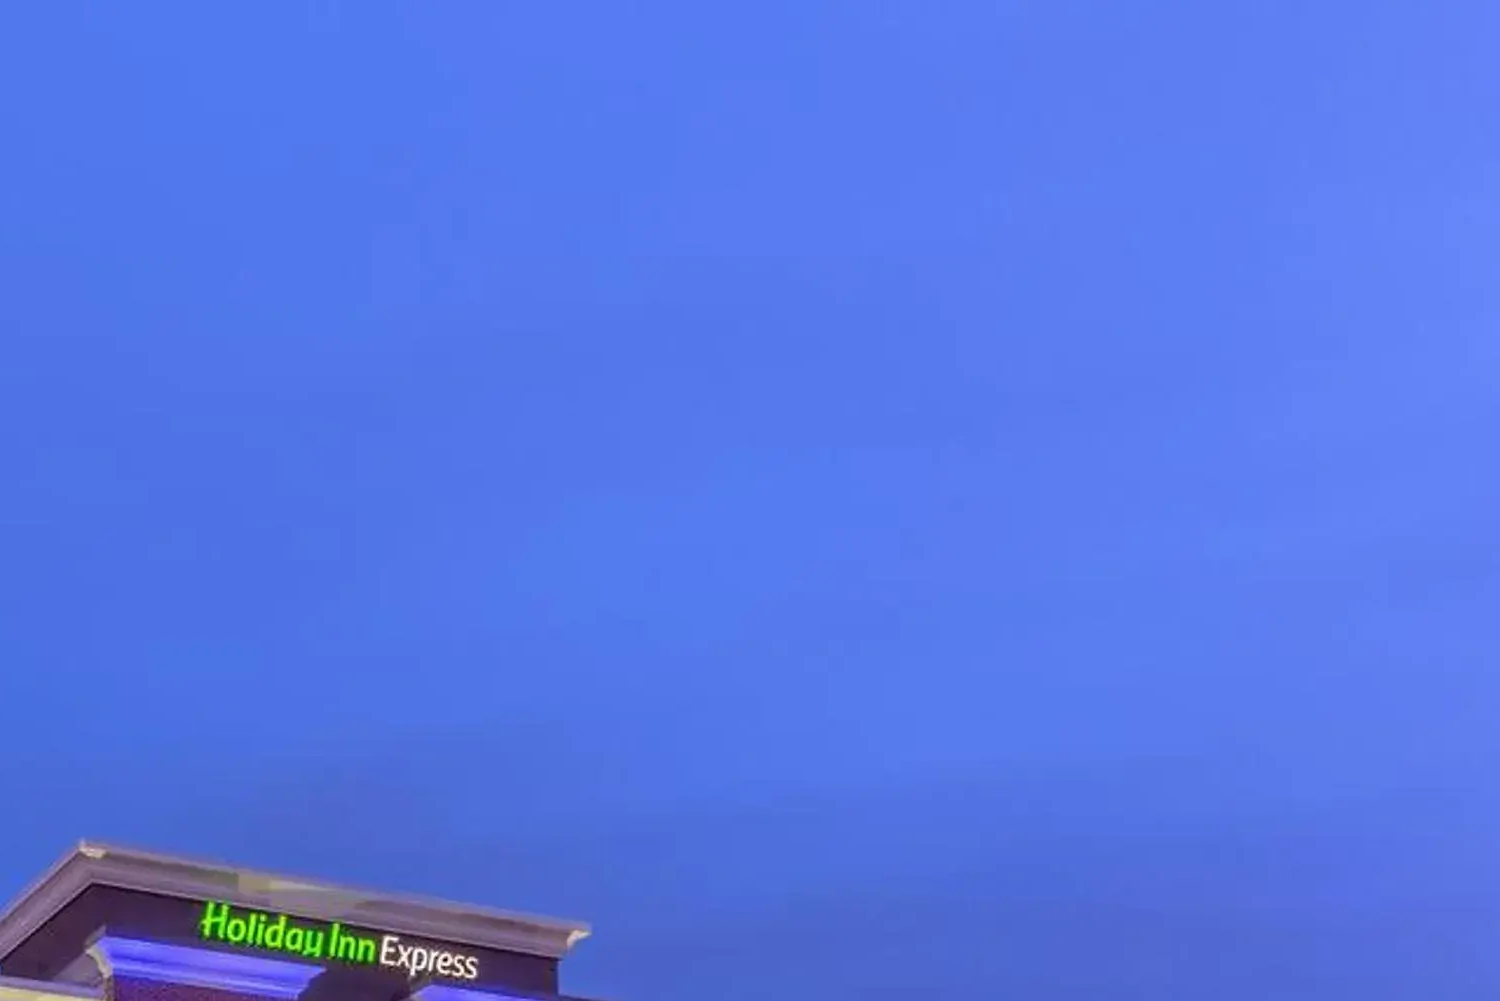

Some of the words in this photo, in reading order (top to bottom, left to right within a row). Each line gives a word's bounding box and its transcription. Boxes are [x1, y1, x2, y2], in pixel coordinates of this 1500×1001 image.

[200, 900, 324, 957] Holiday
[328, 922, 376, 962] Inn
[381, 935, 479, 979] Express
